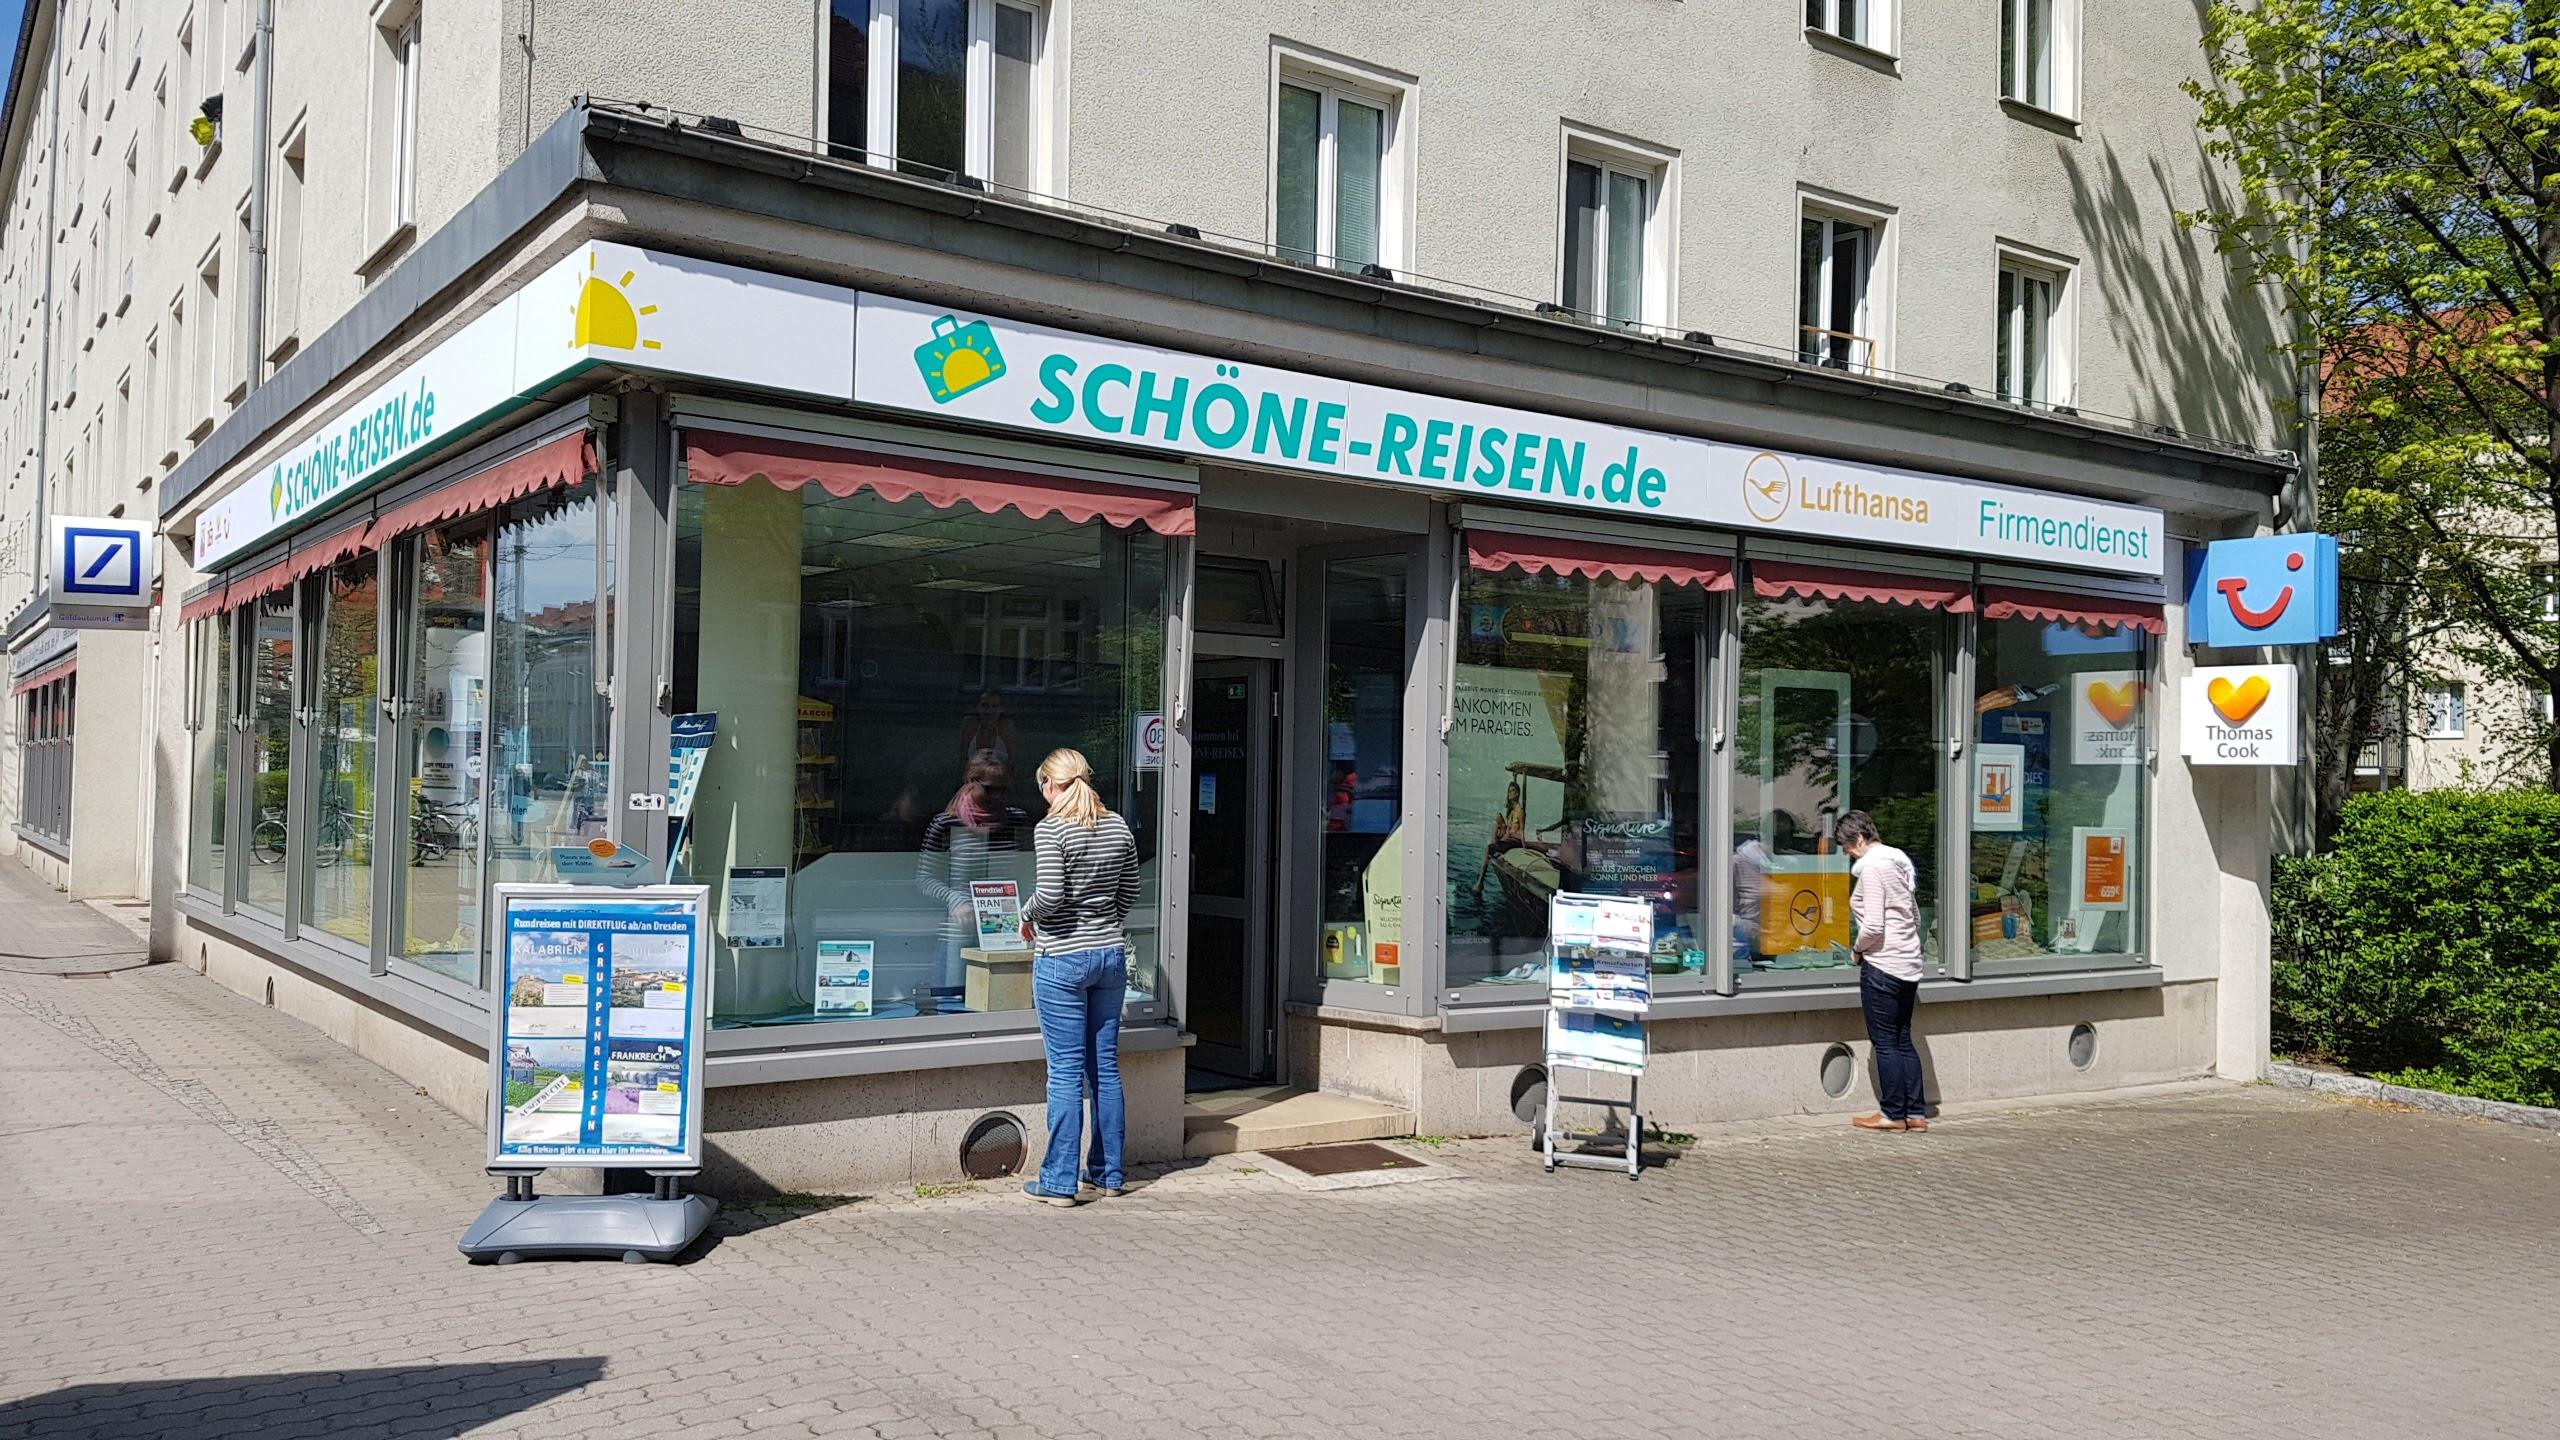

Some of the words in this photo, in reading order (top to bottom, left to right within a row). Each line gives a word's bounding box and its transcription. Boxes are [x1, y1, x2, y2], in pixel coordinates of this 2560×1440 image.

[1029, 354, 1667, 508] SCHÖNE-REISEN.de
[285, 375, 435, 516] SCHÖNE-REISEN.de
[1800, 476, 1929, 524] Lufthansa
[1979, 500, 2149, 559] Firmendienst
[1454, 697, 1532, 717] ANKOMMEN
[1471, 718, 1534, 737] PARADIES.
[2206, 725, 2273, 741] Thomas
[2217, 743, 2259, 758] Cook
[1583, 818, 1671, 838] Signature
[1616, 864, 1657, 873] ZWISCHEN
[1590, 873, 1619, 881] SONNE
[1621, 873, 1638, 882] UND
[1638, 873, 1658, 882] MEER
[974, 886, 1004, 894] Trendziel
[976, 899, 1000, 908] IRAN
[513, 917, 561, 928] Rundreisen
[562, 919, 577, 929] mit
[577, 920, 627, 930] DIREKTFLUG
[627, 921, 652, 931] ab/an
[653, 921, 687, 931] Dresden
[513, 944, 582, 955] KALABRIEN
[587, 942, 605, 1131] GRUPPENREISEN
[611, 1051, 667, 1061] FRANKREICH
[533, 1146, 558, 1154] Reisen
[559, 1146, 576, 1156] gibt
[601, 1146, 617, 1155] hier
[618, 1146, 629, 1155] im
